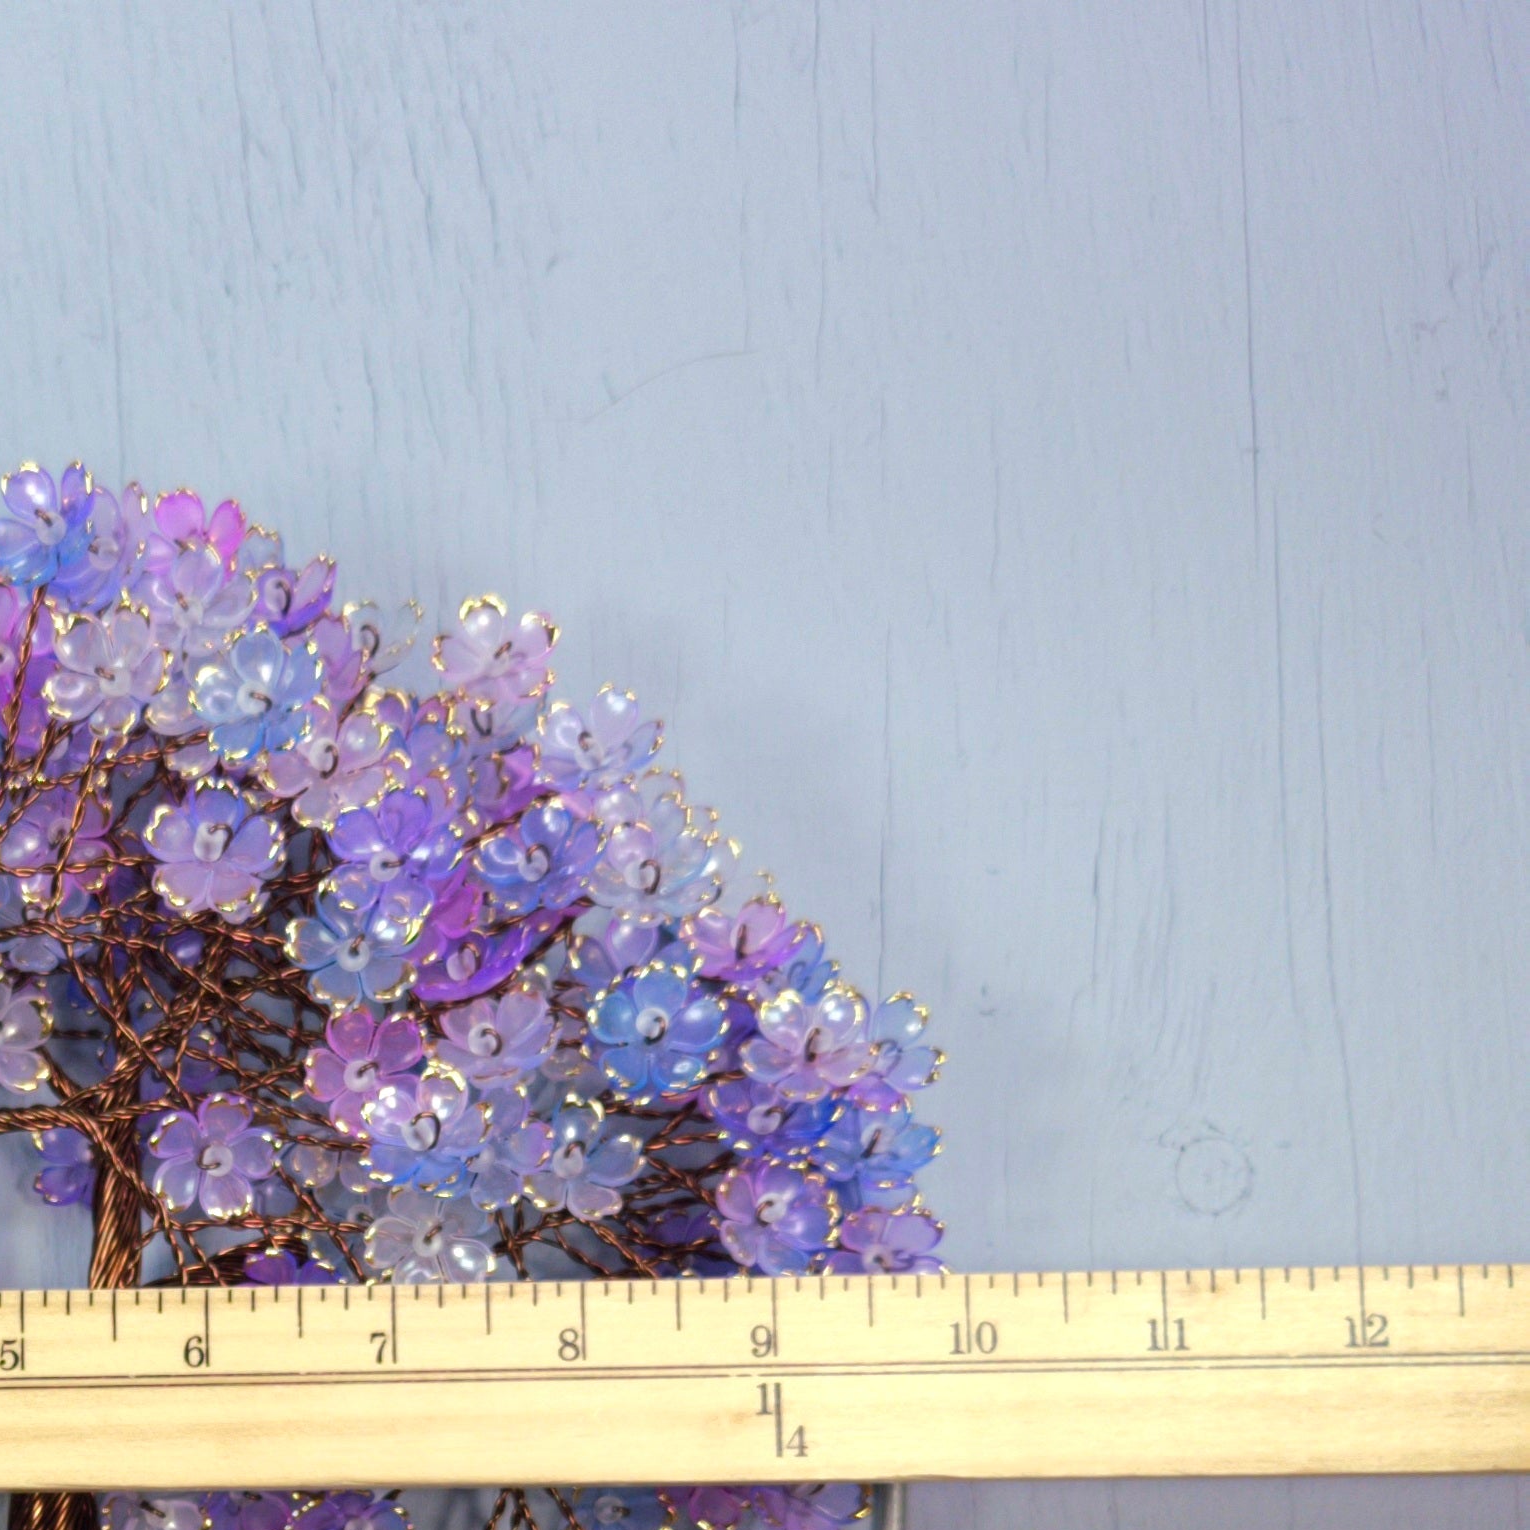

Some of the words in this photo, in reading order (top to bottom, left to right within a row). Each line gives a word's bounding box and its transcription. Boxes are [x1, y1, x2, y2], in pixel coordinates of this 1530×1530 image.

[0, 1338, 20, 1371] 5
[183, 1336, 205, 1368] 6
[369, 1332, 388, 1365] 7
[557, 1328, 581, 1361] 8
[750, 1324, 773, 1357] 9
[949, 1322, 999, 1355] 10
[1147, 1318, 1190, 1351] 11
[1344, 1314, 1390, 1348] 12
